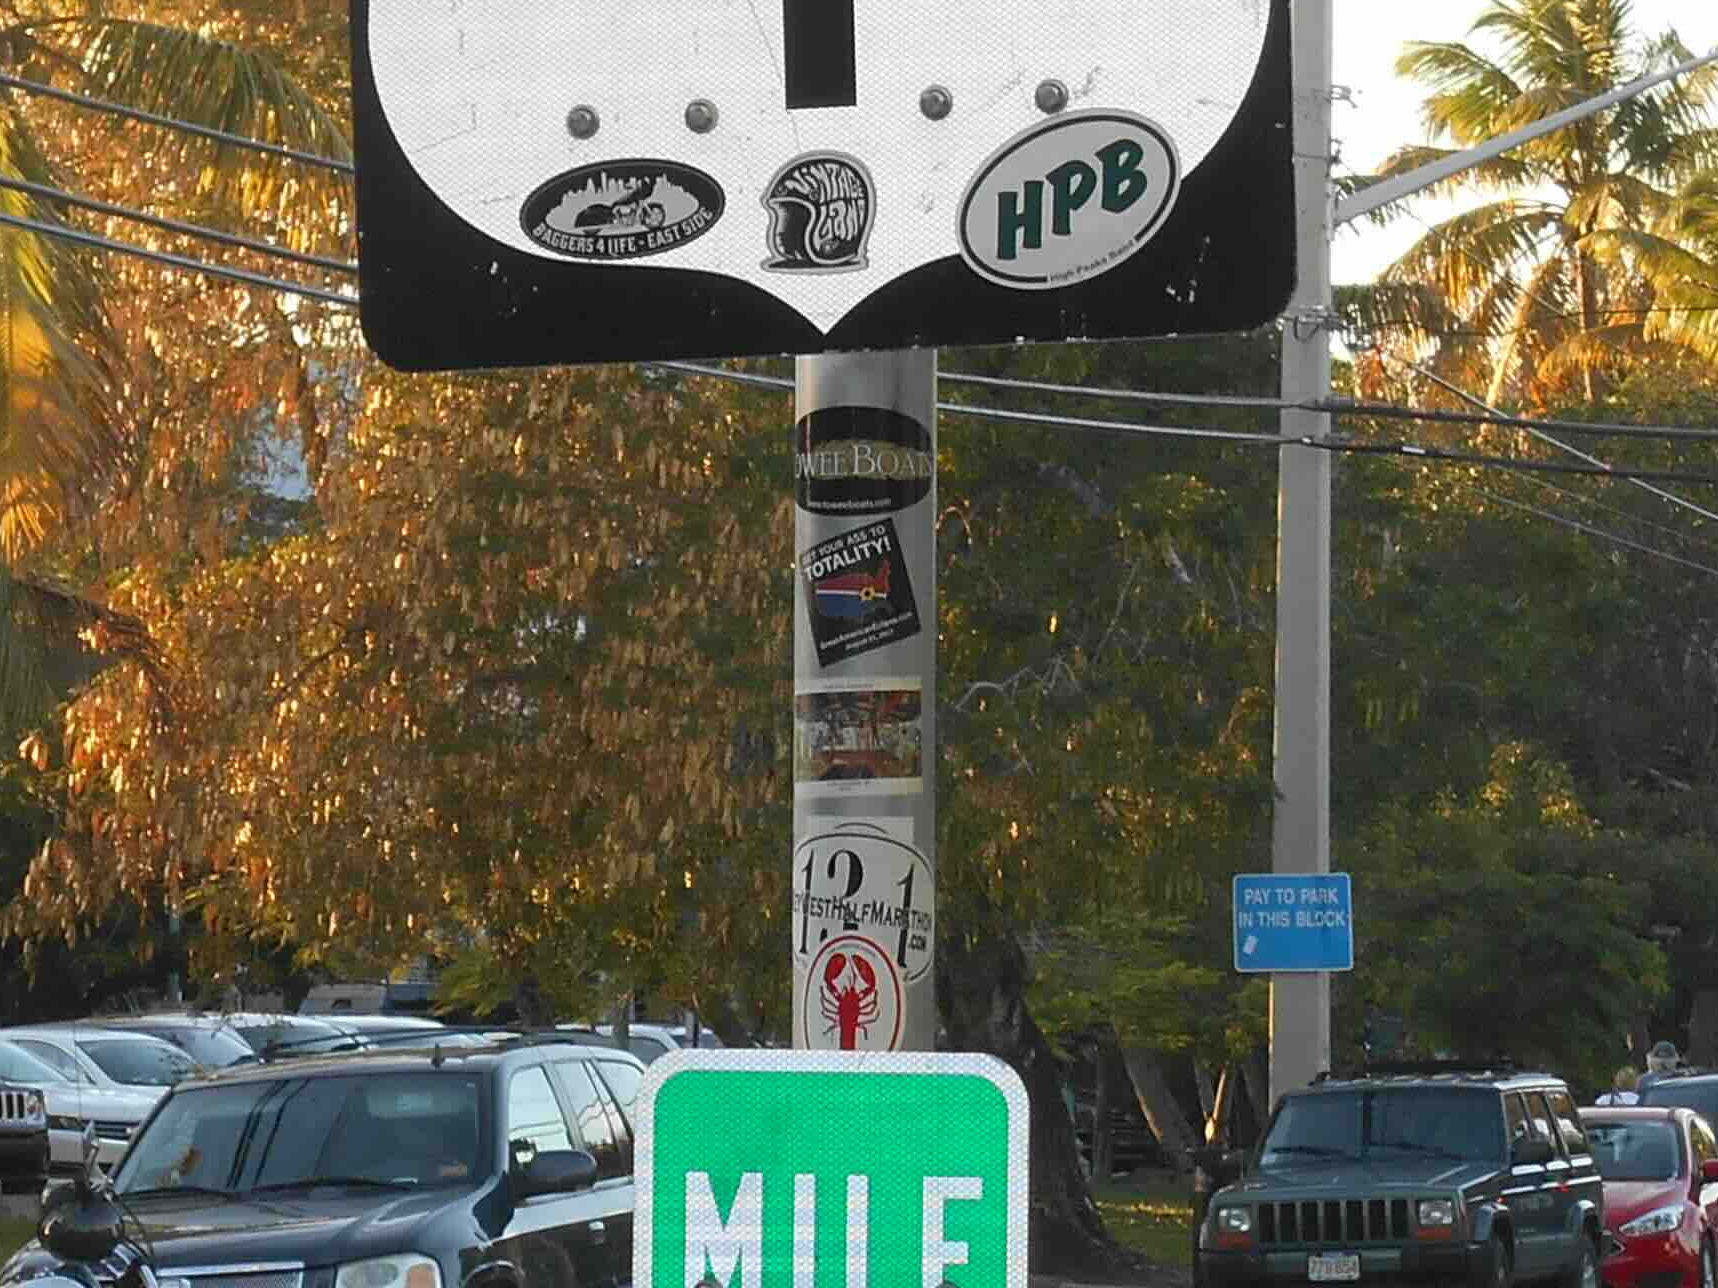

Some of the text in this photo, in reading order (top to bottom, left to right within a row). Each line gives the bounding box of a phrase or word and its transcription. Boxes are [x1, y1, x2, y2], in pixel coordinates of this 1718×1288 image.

[997, 139, 1148, 261] HPB
[533, 207, 714, 257] BAGGERS 4 LIFE EAST SIDE
[803, 535, 892, 581] TOTALITY!
[1244, 887, 1340, 905] PAY TO PARK
[1238, 910, 1346, 929] IN THIS BLOCK
